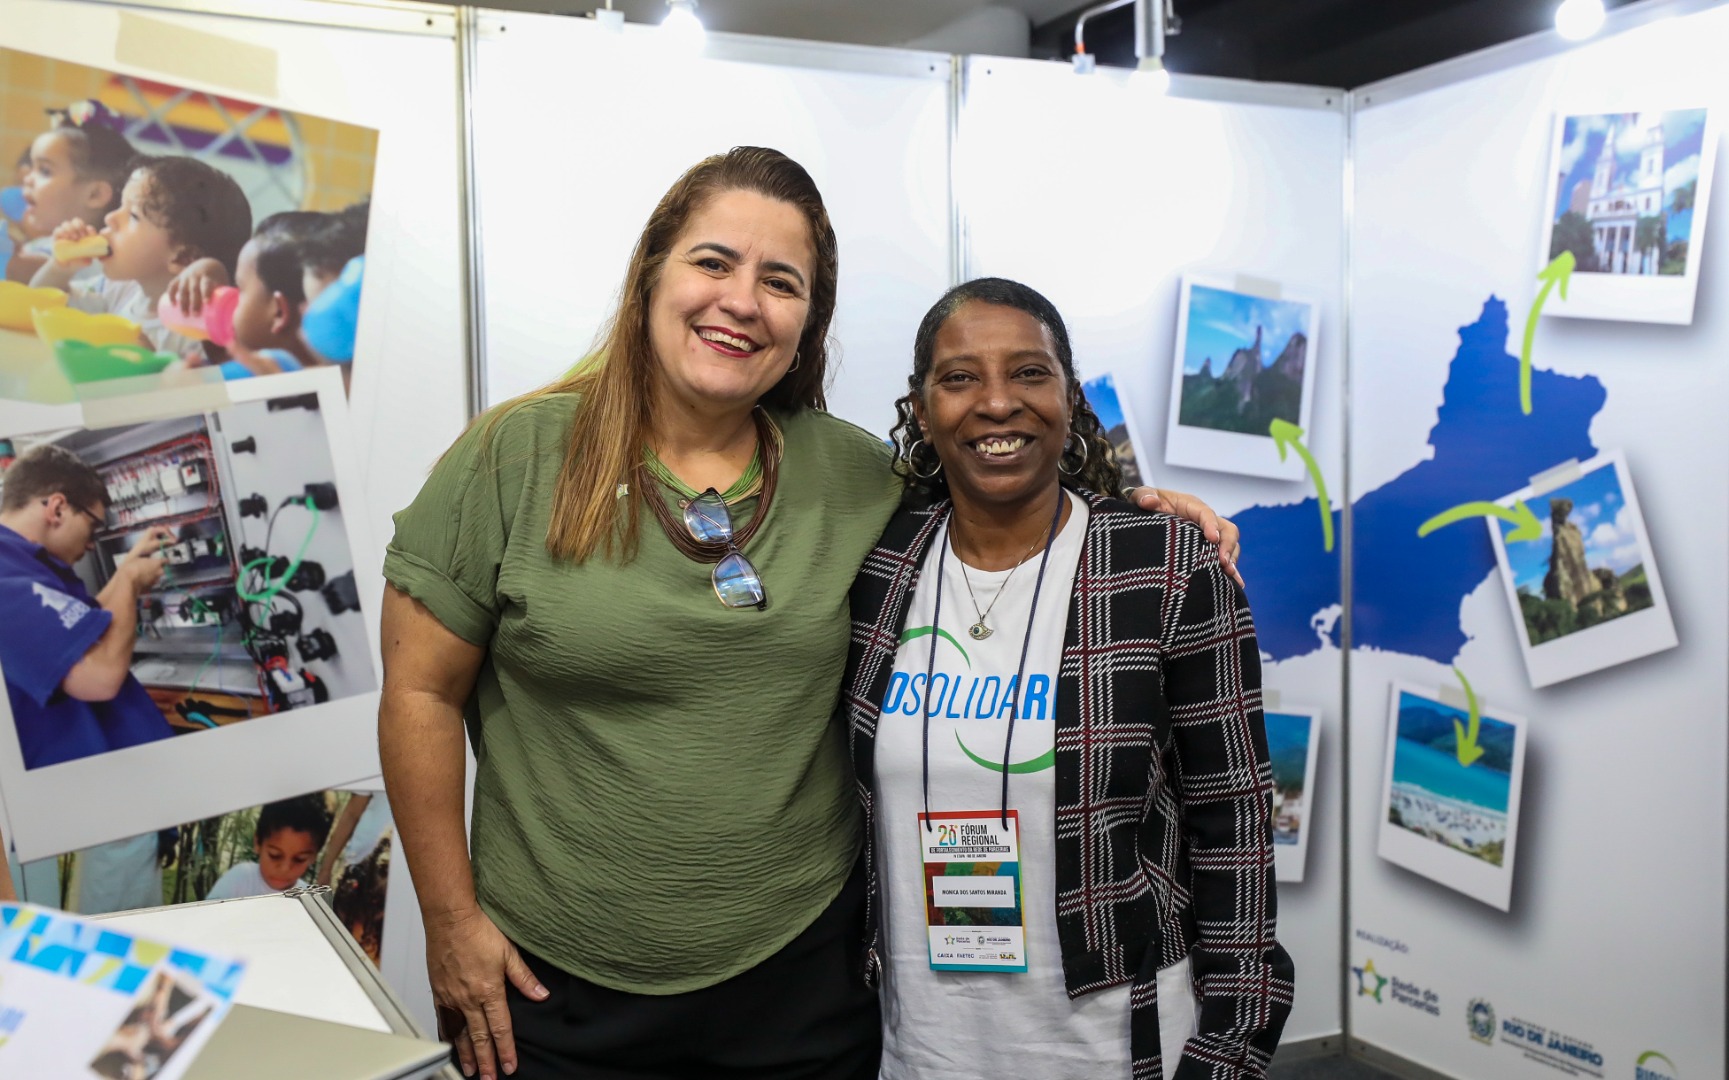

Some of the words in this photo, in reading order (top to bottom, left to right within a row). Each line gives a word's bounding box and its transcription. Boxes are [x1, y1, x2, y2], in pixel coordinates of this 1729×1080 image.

[960, 823, 988, 835] FÓRUM
[961, 835, 999, 846] REGIONAL
[1391, 975, 1420, 996] Rede
[1423, 989, 1439, 1003] de
[1391, 989, 1440, 1016] Parcerias
[1503, 1020, 1525, 1037] RIO
[1527, 1030, 1544, 1045] DE
[1547, 1037, 1604, 1067] JANEIRO
